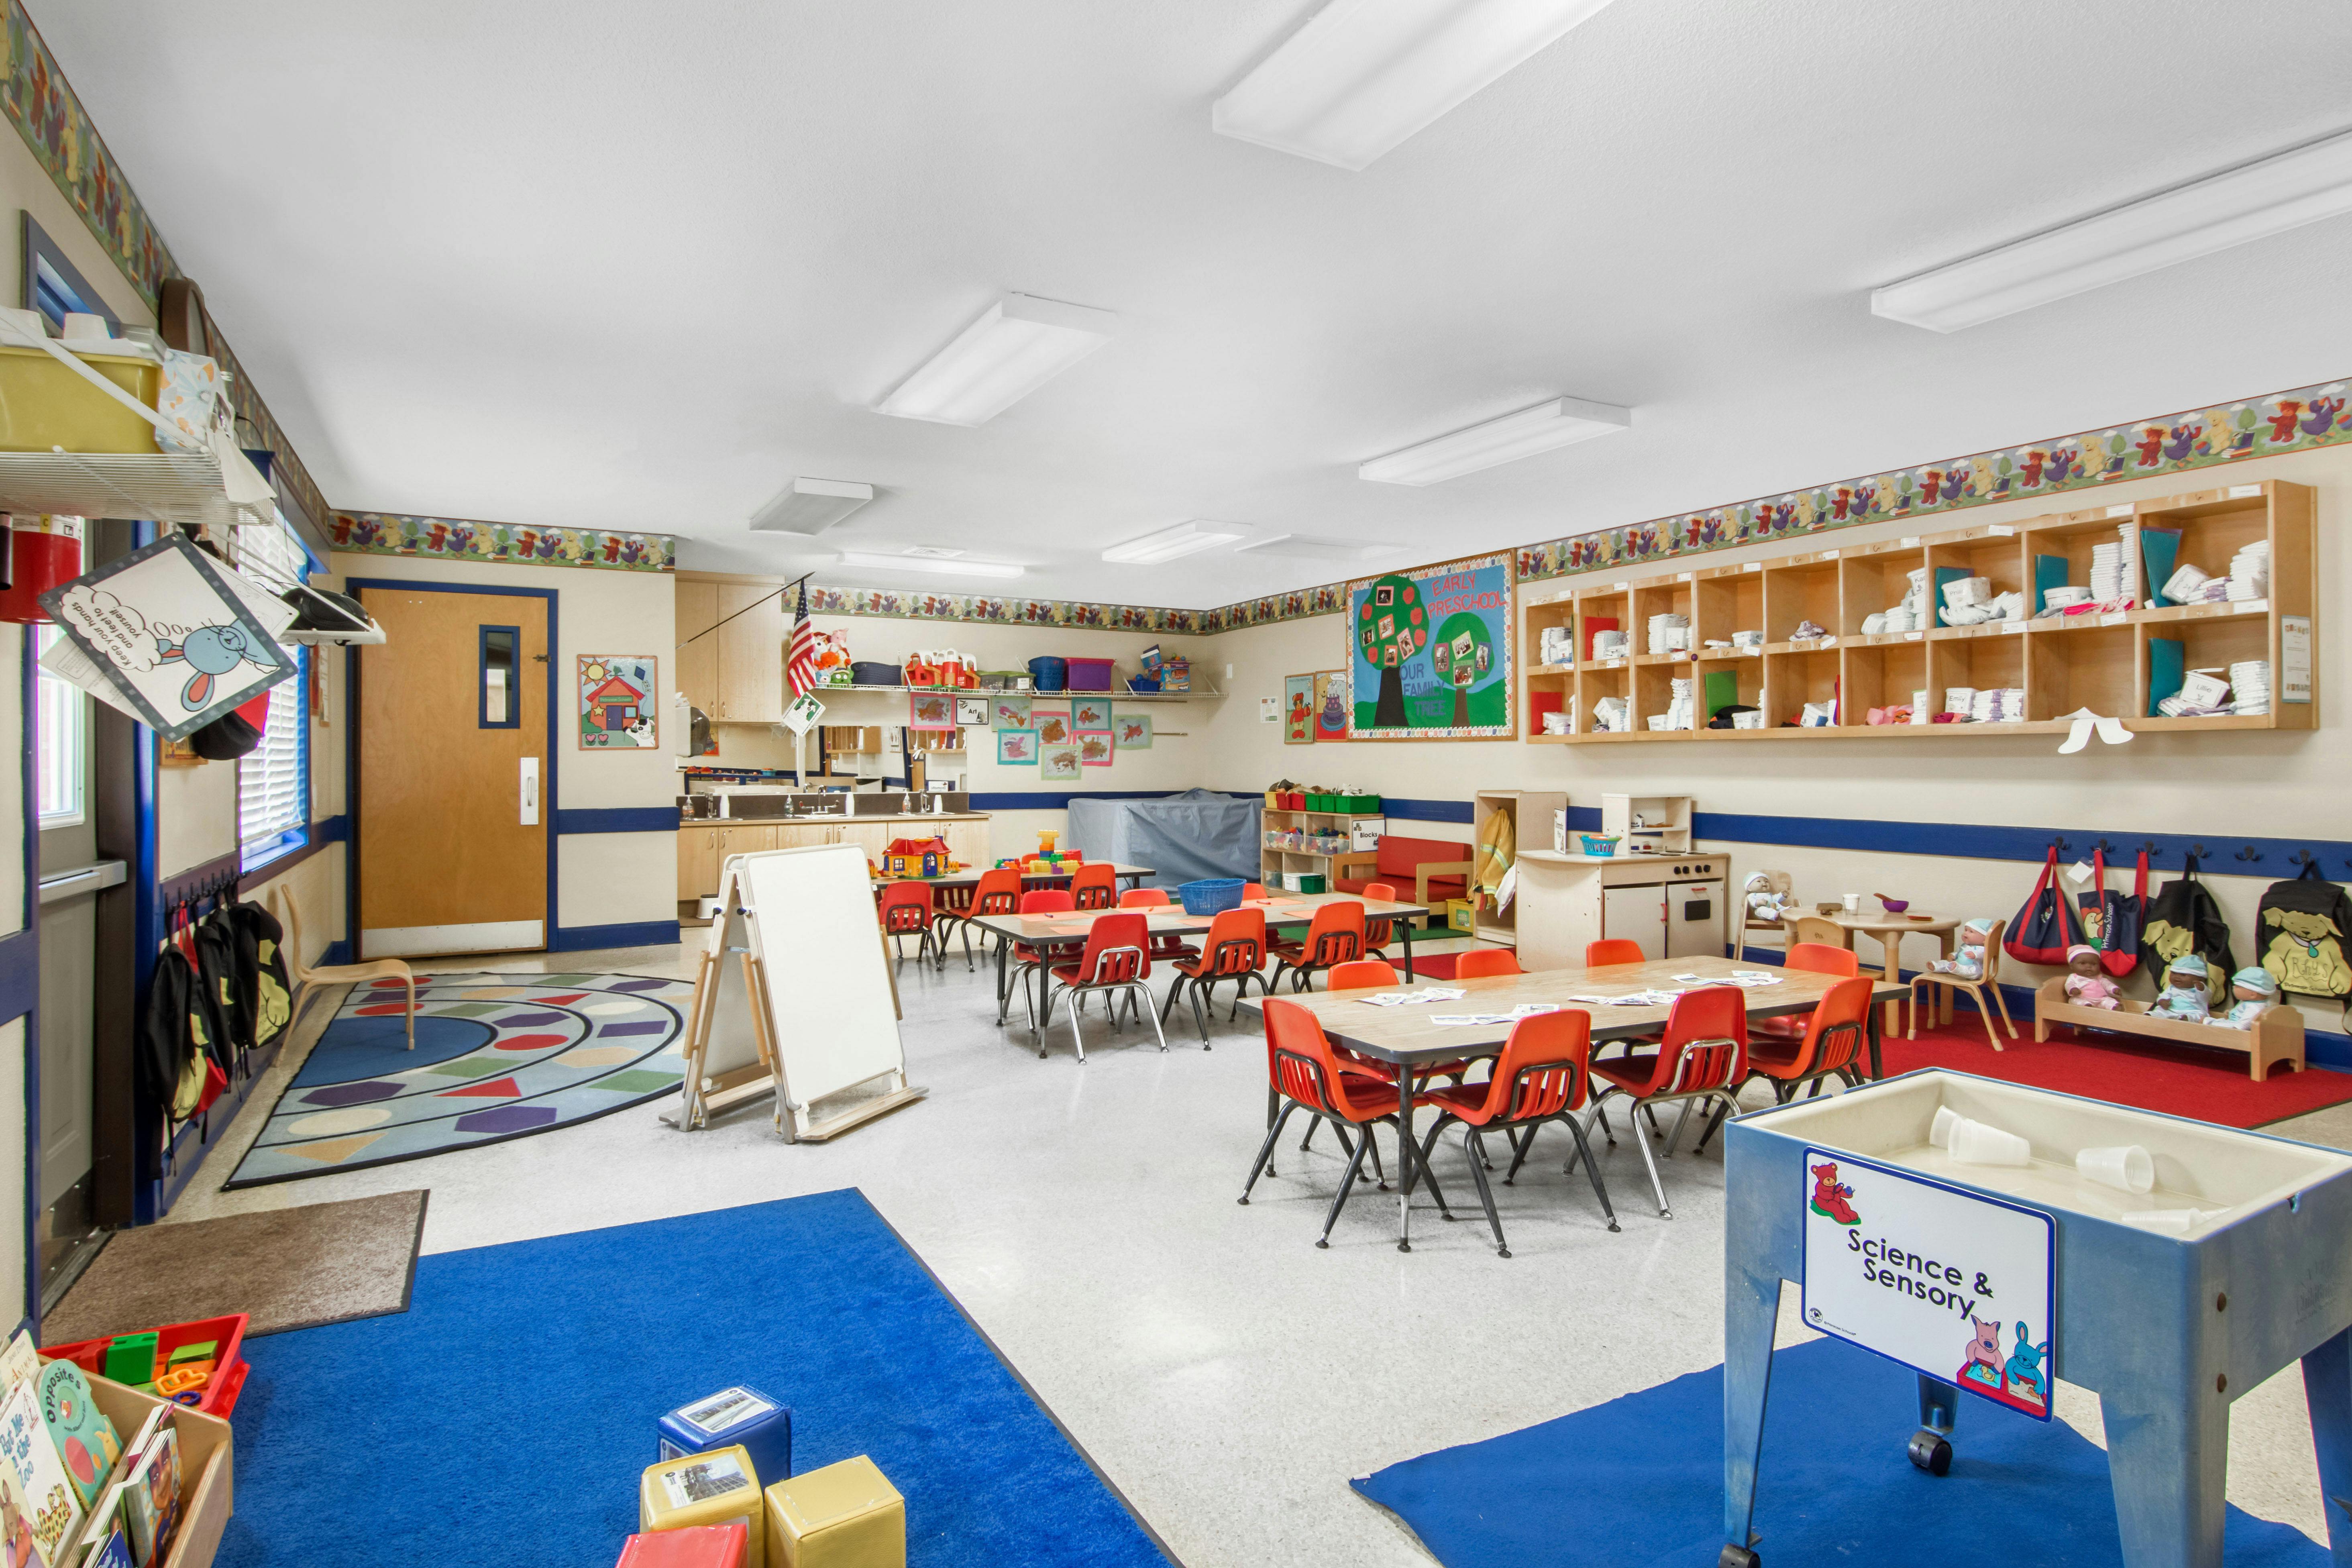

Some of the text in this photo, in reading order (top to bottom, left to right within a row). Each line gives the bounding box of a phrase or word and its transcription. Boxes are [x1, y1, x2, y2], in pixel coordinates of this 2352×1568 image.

[1432, 572, 1476, 597] EARLY
[72, 602, 96, 627] hands
[1428, 591, 1507, 619] PRESCHOOL
[94, 608, 133, 648] and feet to
[109, 607, 142, 638] yourself.
[94, 627, 114, 644] your
[111, 645, 131, 666] Keep
[1400, 663, 1424, 681] OUR
[1403, 680, 1445, 698] FAMILY
[2196, 684, 2212, 693] Lillie
[1414, 700, 1445, 716] TREE
[2101, 923, 2112, 949] Primrose
[1847, 1229, 1994, 1299] Science &
[1863, 1258, 1976, 1320] Sensory
[11, 1413, 24, 1438] Me
